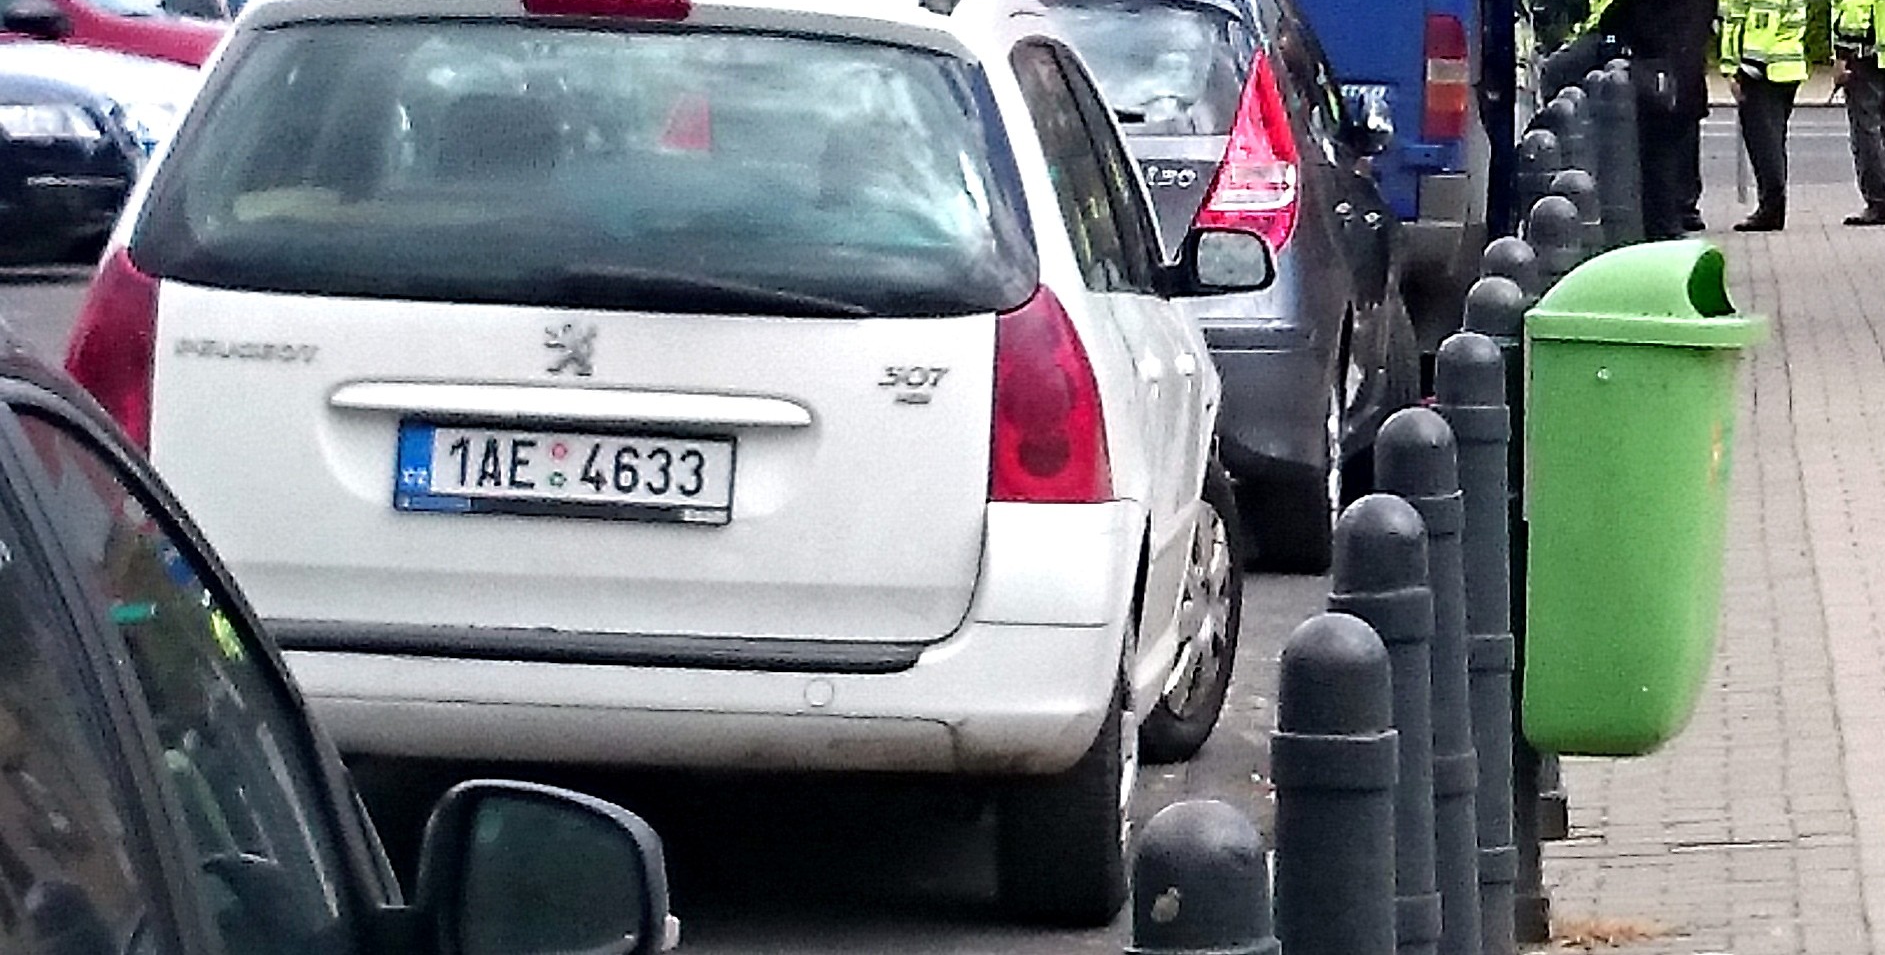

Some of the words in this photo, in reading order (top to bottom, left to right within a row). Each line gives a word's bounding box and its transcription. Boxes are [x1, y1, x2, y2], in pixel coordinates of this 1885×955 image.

[175, 337, 319, 364] PEUGEOT
[877, 366, 950, 388] 307
[449, 435, 537, 490] 1AE
[580, 441, 707, 498] 4633
